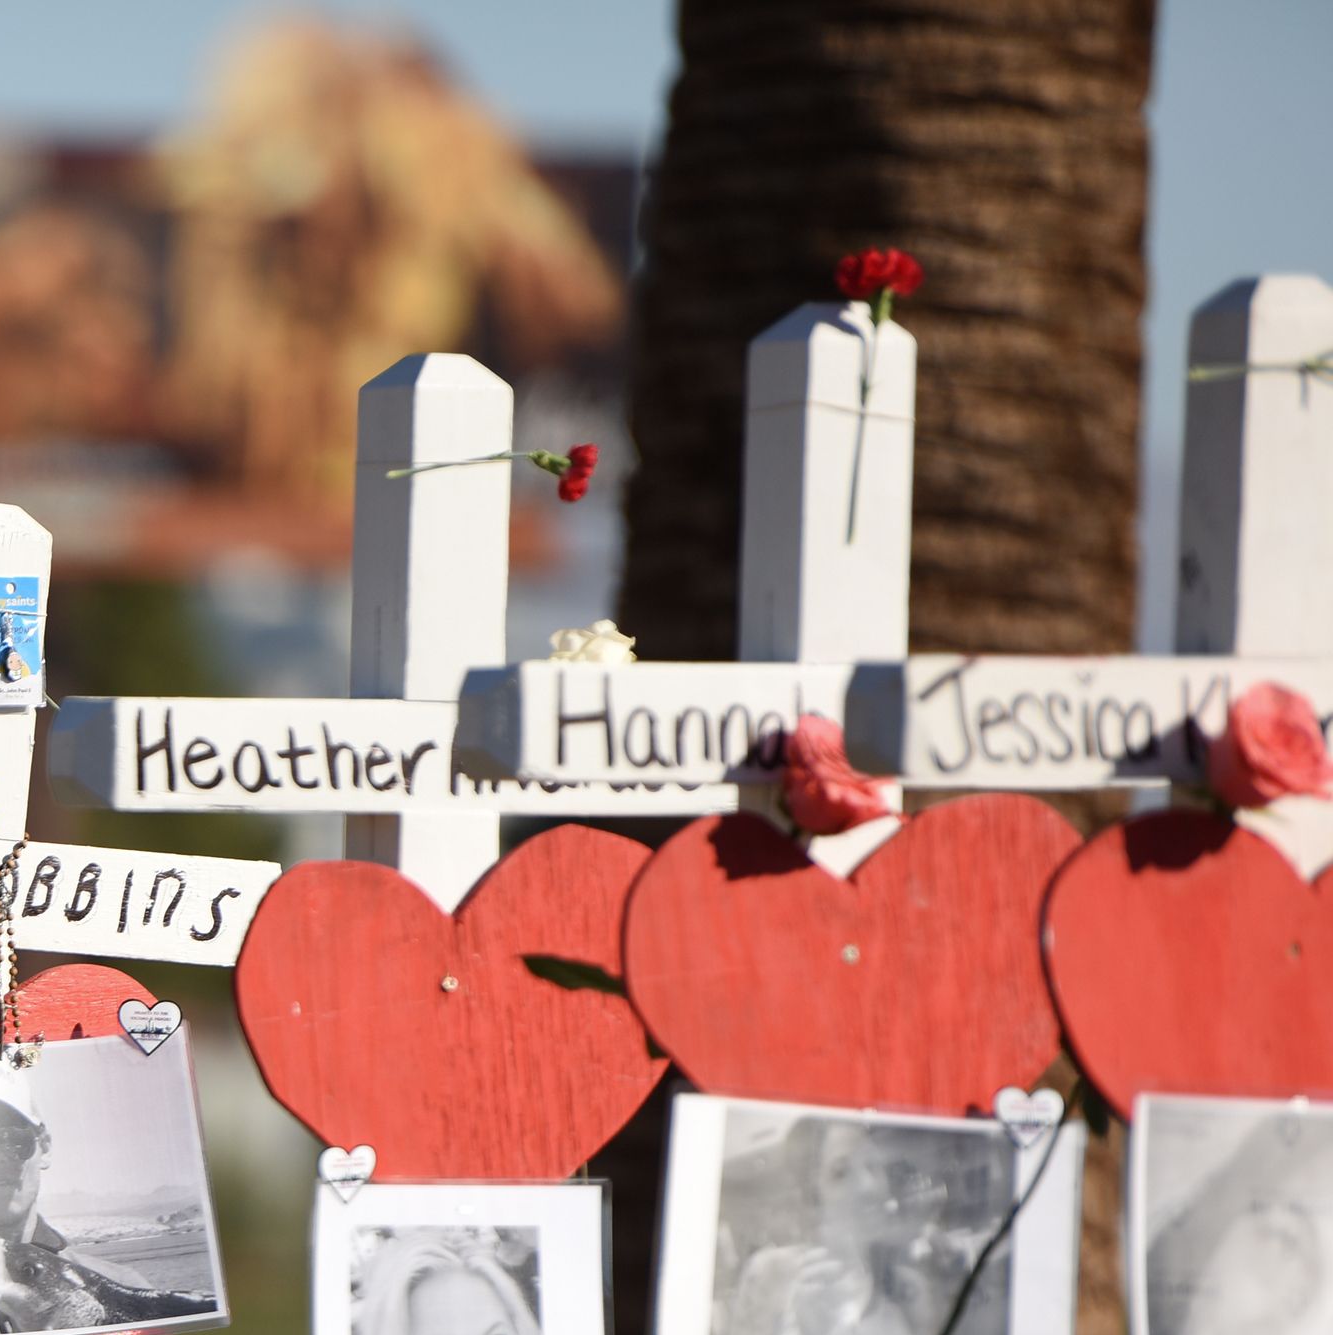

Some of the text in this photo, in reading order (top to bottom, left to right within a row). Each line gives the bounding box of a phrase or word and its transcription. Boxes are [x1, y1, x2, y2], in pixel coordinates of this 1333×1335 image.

[135, 707, 438, 795] Heather
[556, 671, 825, 769] Hanna
[918, 659, 1160, 775] Jessica
